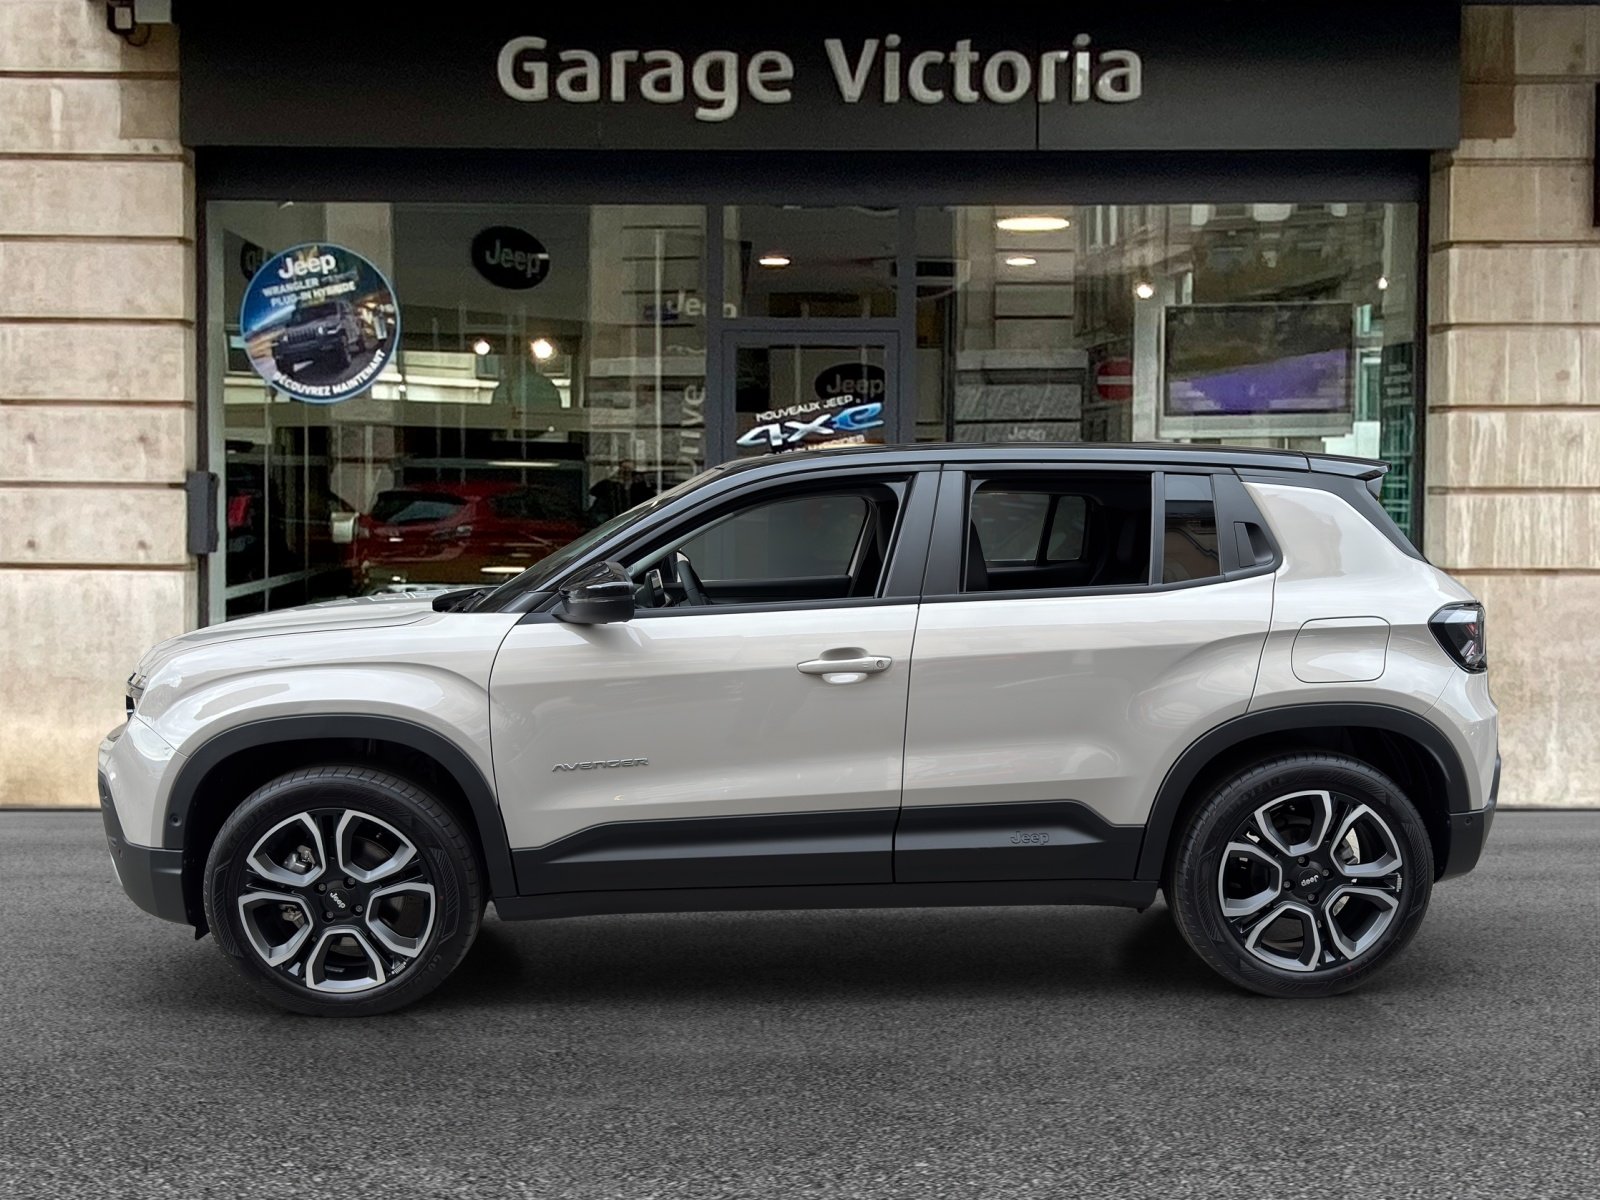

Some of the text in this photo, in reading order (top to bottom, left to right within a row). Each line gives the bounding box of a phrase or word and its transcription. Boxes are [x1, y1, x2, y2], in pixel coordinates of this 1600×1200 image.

[497, 33, 1143, 122] Garage Victoria
[278, 254, 337, 279] Jeep
[485, 239, 541, 278] Jeep
[262, 277, 320, 297] WRANGLER
[272, 349, 386, 396] DÉCOUVREZ MAINTENANT
[826, 373, 885, 398] Jeep
[756, 394, 853, 422] NOUVEAUX JEEP
[552, 758, 649, 772] AVENGER
[1010, 830, 1049, 845] Jeep
[1301, 875, 1319, 887] Jeep
[330, 892, 346, 909] Jeep
